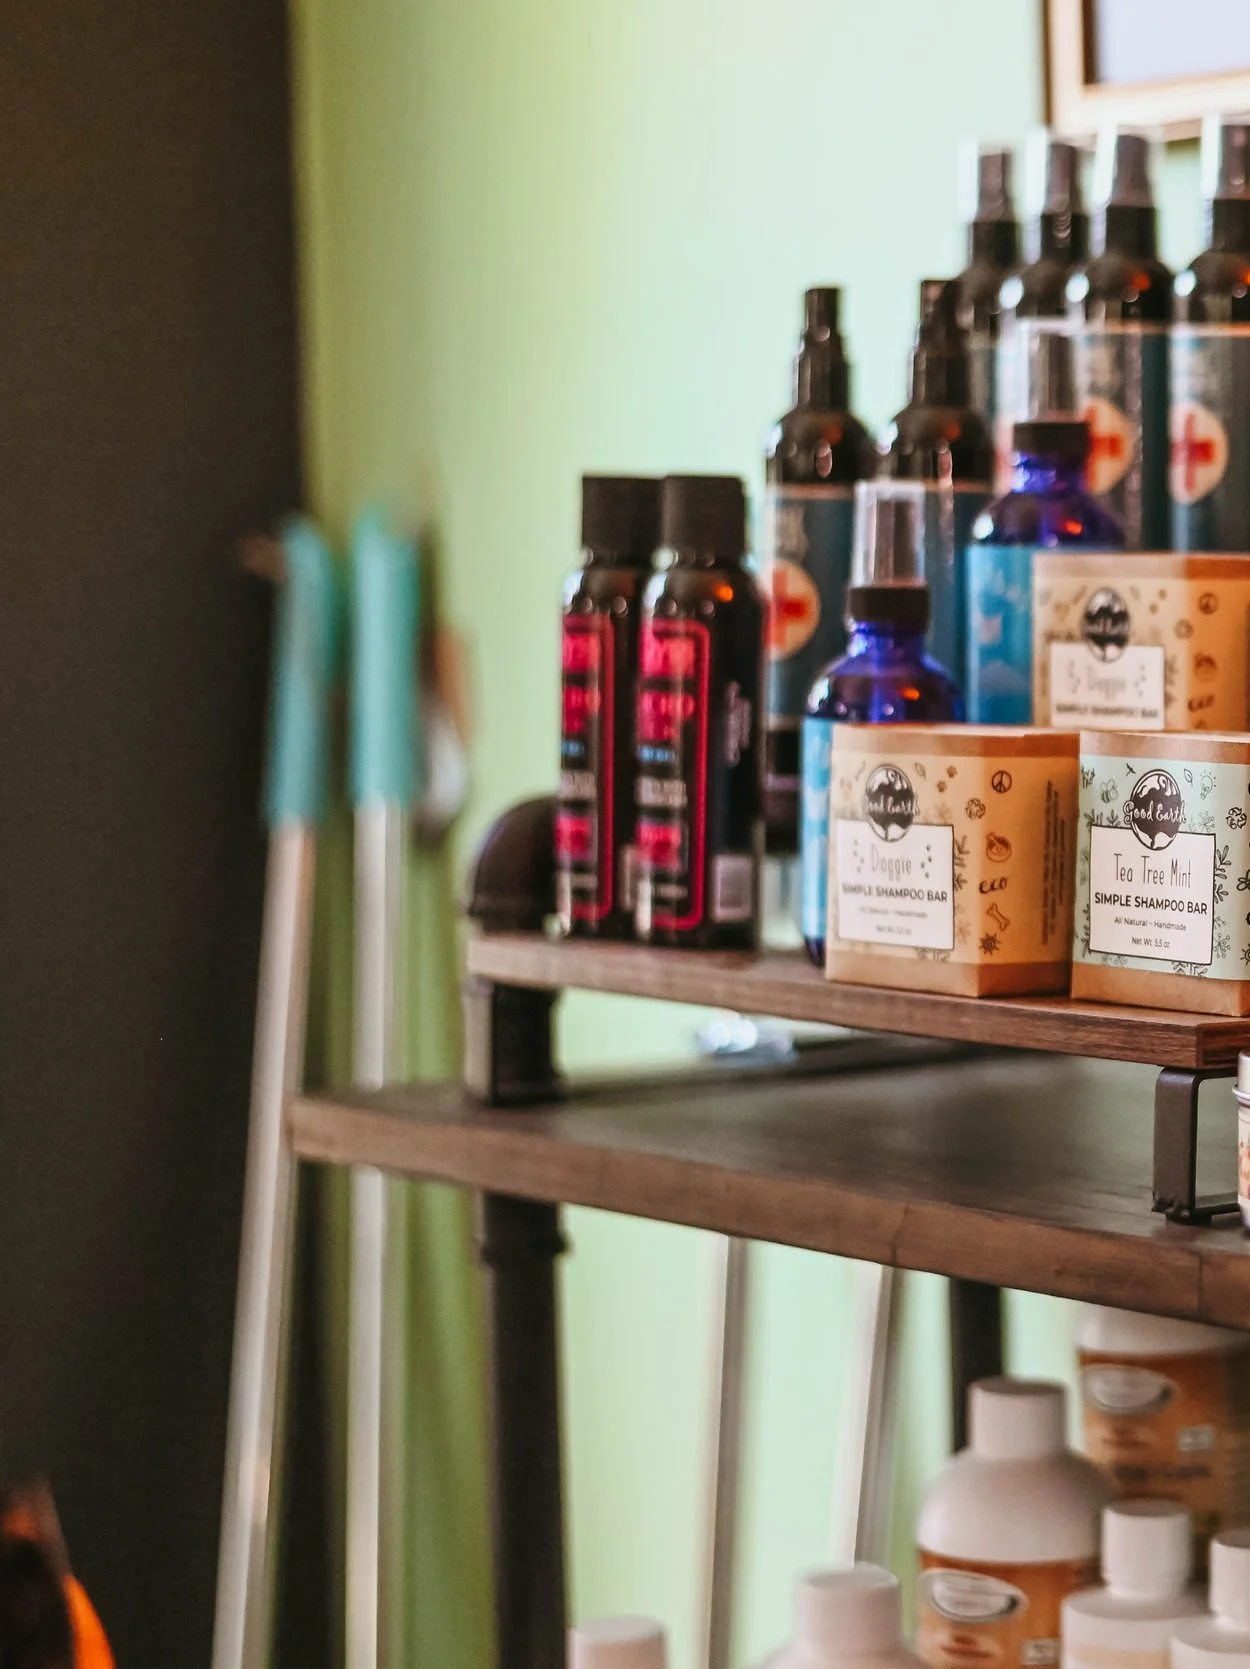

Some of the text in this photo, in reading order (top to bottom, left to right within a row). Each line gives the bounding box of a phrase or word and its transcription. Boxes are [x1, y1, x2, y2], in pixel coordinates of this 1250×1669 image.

[1123, 800, 1187, 825] Good Earth
[1114, 853, 1192, 889] Tea Tree Mint
[842, 883, 948, 903] SIMPLE SHAMPOO BAR
[979, 877, 1010, 895] eco
[1094, 891, 1208, 915] SIMPLE SHAMPOO BAR
[1114, 916, 1122, 924] All
[1124, 917, 1148, 927] Natural
[1154, 921, 1187, 931] Handmade
